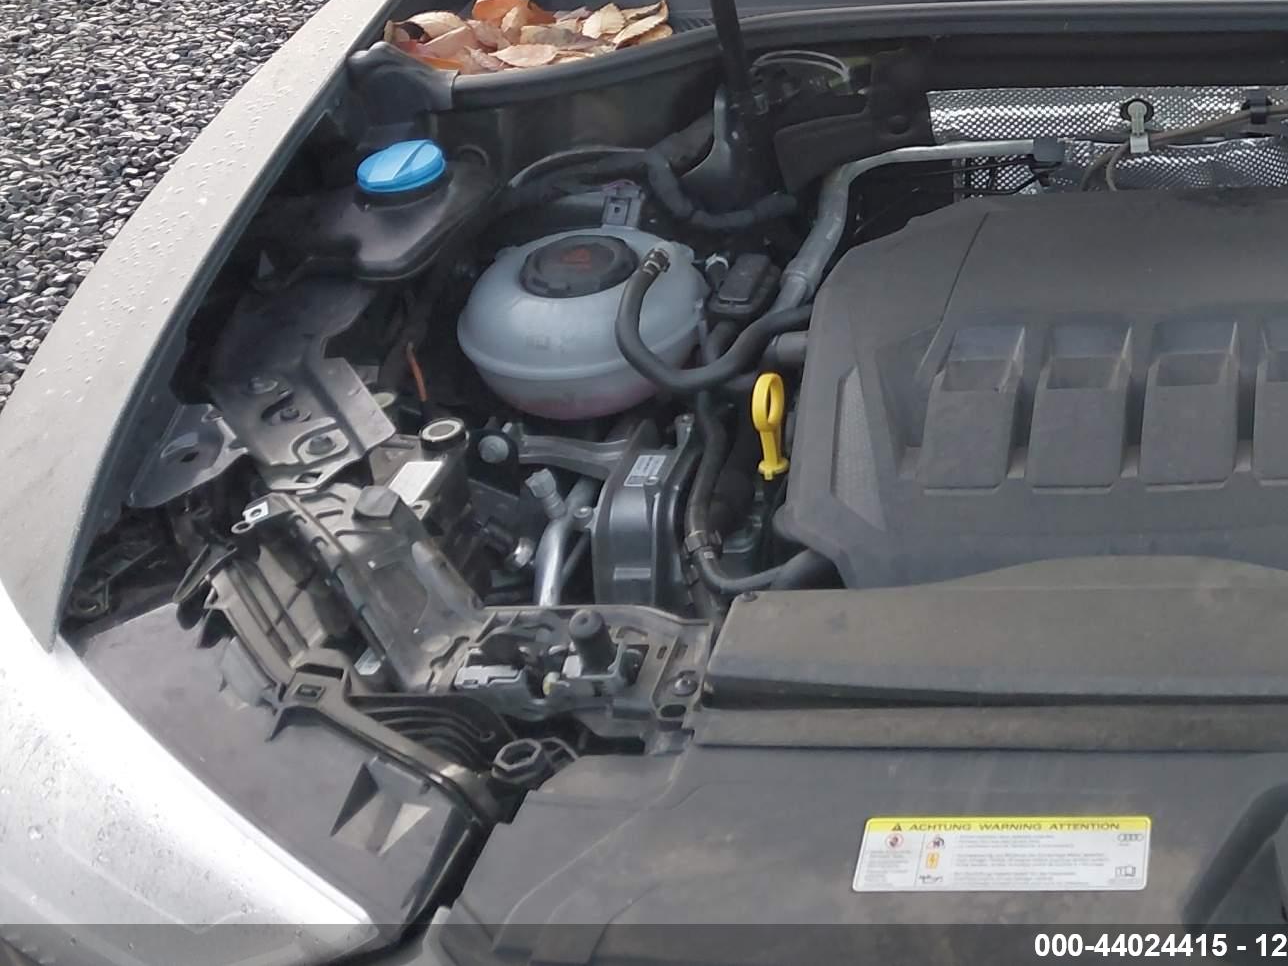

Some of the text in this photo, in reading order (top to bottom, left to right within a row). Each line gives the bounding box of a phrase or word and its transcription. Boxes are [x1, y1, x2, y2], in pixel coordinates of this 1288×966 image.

[910, 822, 1120, 832] ACHTUNG WARNING ATTENTION
